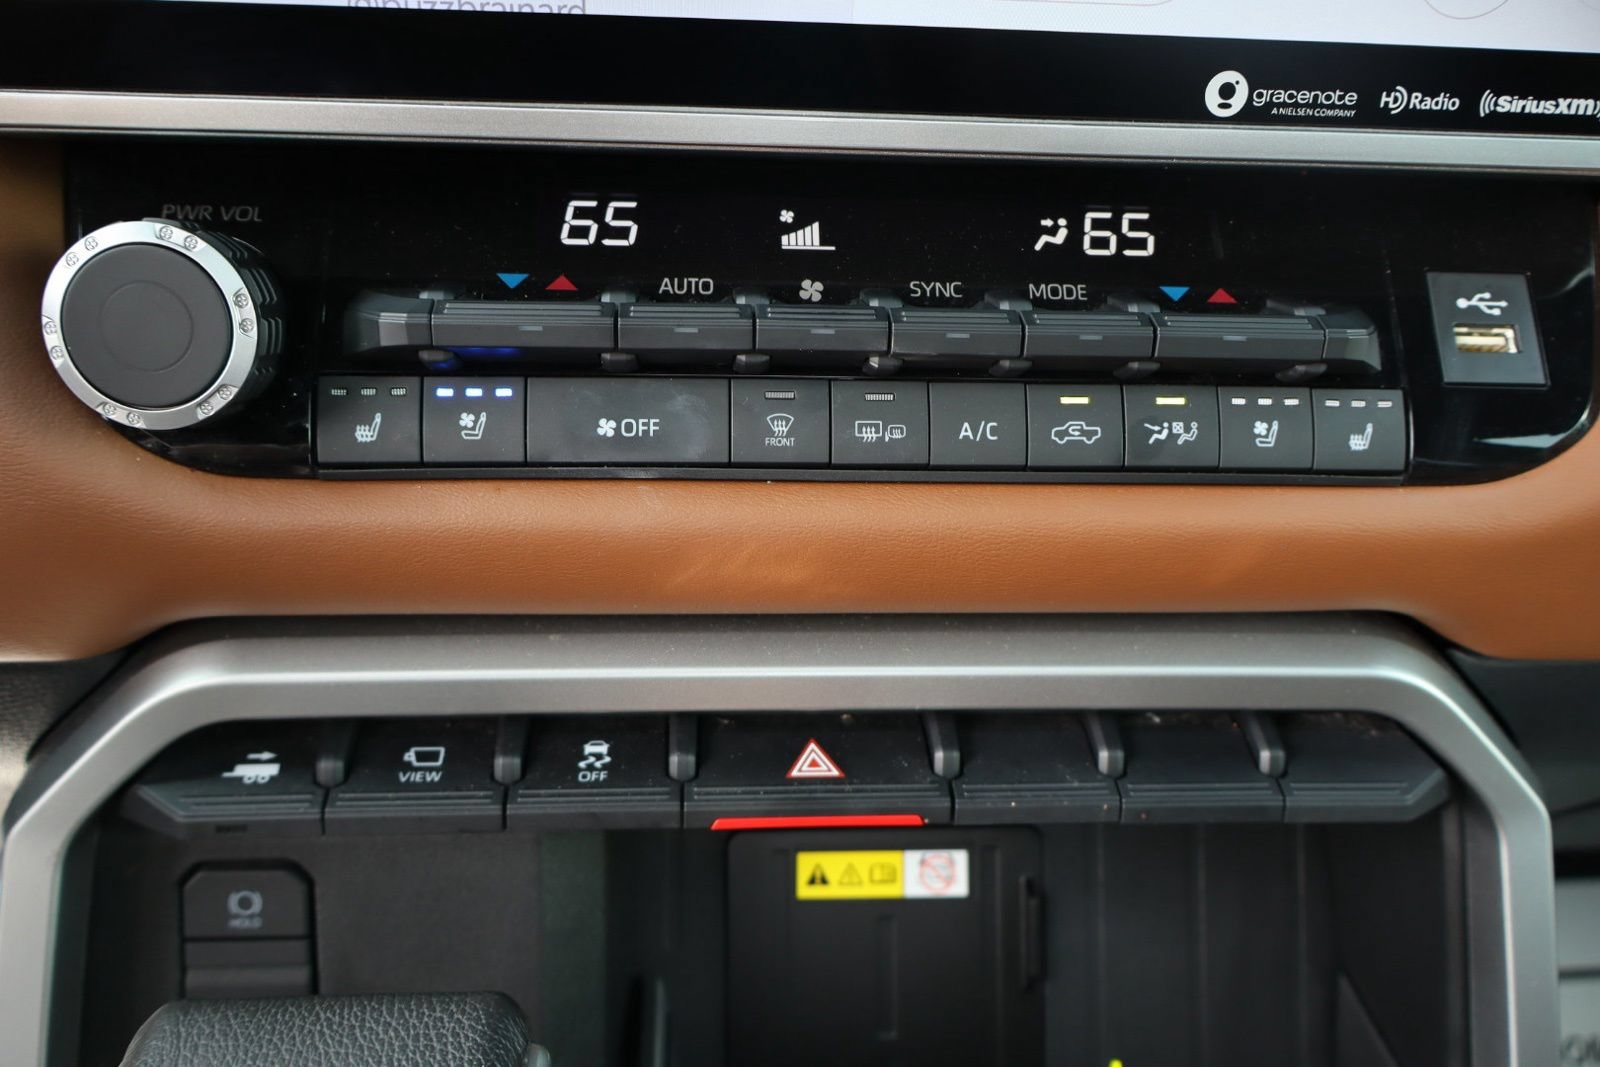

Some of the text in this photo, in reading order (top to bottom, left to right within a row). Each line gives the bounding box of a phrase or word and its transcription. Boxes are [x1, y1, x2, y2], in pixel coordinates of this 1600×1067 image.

[1253, 89, 1358, 106] gracenote
[1380, 86, 1460, 114] HD Radio
[1271, 107, 1357, 117] A NIELSEN COMPANY
[161, 204, 263, 222] PWR VOL
[560, 200, 638, 246] 65
[1083, 211, 1155, 256] 65
[659, 278, 714, 295] AUTO
[909, 281, 963, 298] SYNC
[1029, 283, 1088, 301] MODE
[621, 418, 660, 437] OFF
[958, 421, 999, 441] A/C
[765, 434, 795, 447] FRONT
[399, 771, 442, 783] VIEW
[578, 770, 608, 783] OFF
